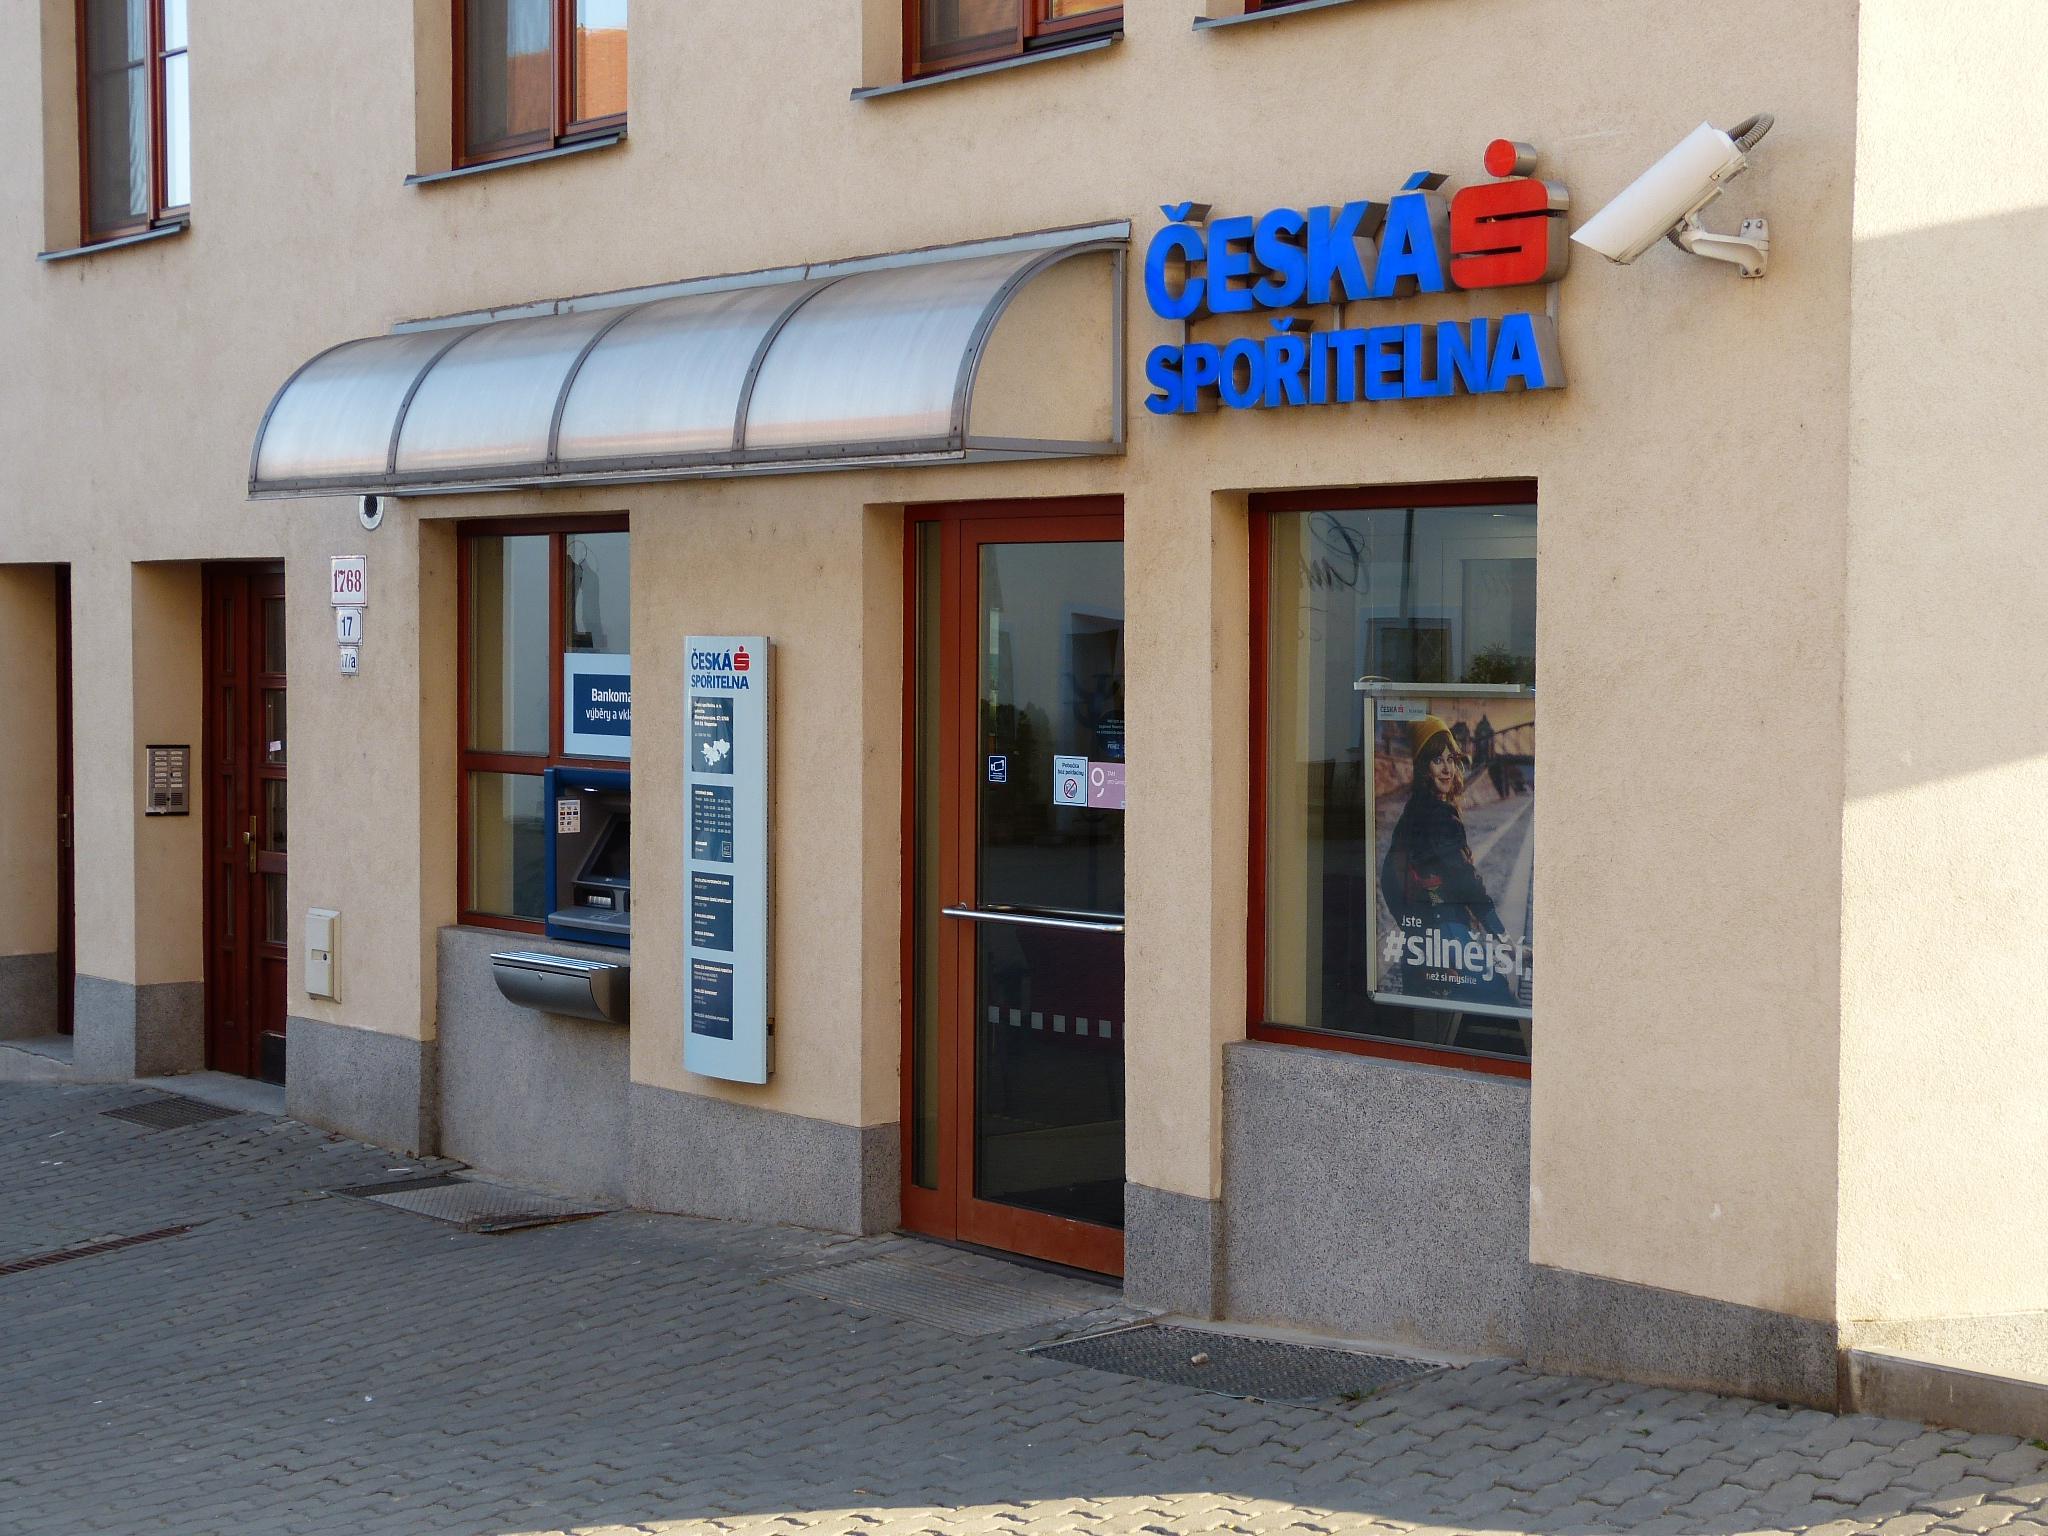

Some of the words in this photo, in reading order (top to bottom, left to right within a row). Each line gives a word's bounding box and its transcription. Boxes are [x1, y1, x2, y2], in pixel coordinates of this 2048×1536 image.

[1144, 170, 1447, 320] ČESKÁ
[1143, 317, 1544, 415] SPOŘITELNA
[333, 569, 362, 592] 1768
[341, 616, 353, 636] 17
[691, 648, 732, 671] ČESKÁ
[691, 672, 749, 689] SPOŘITELNA
[585, 707, 611, 722] výběry
[612, 710, 618, 720] a
